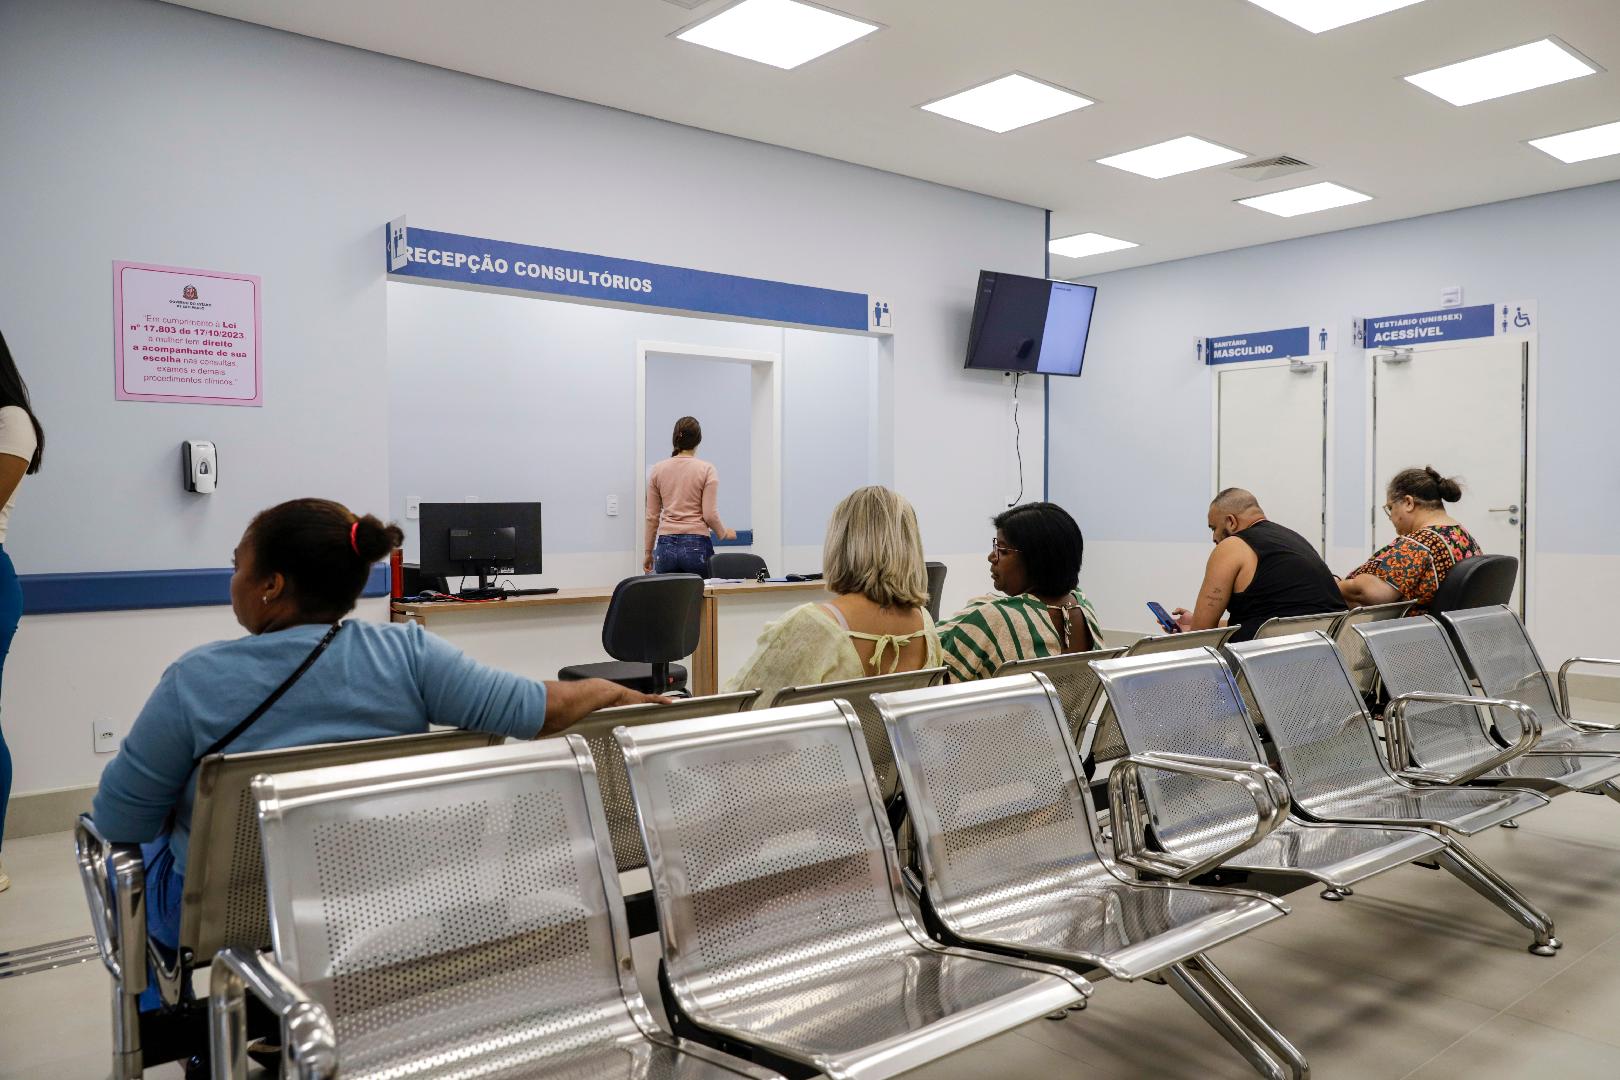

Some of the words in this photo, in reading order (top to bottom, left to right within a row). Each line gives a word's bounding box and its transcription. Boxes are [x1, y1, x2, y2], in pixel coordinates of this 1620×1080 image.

[405, 246, 509, 274] RECEPÇÃO
[514, 261, 653, 293] CONSULTÓRIOS
[222, 321, 237, 329] Lei
[1374, 319, 1417, 329] VESTIÁRIO
[1419, 313, 1463, 325] (UNISSEX)
[143, 324, 177, 334] 17.803
[179, 327, 191, 335] de
[1373, 326, 1444, 342] ACESSÍVEL
[202, 338, 233, 348] direito
[1213, 339, 1247, 348] SANITÁRIO
[142, 345, 214, 356] acompanhante
[1213, 344, 1274, 359] MASCULINO
[142, 355, 181, 363] escolha
[197, 367, 226, 376] demais
[143, 375, 202, 384] procedimentos
